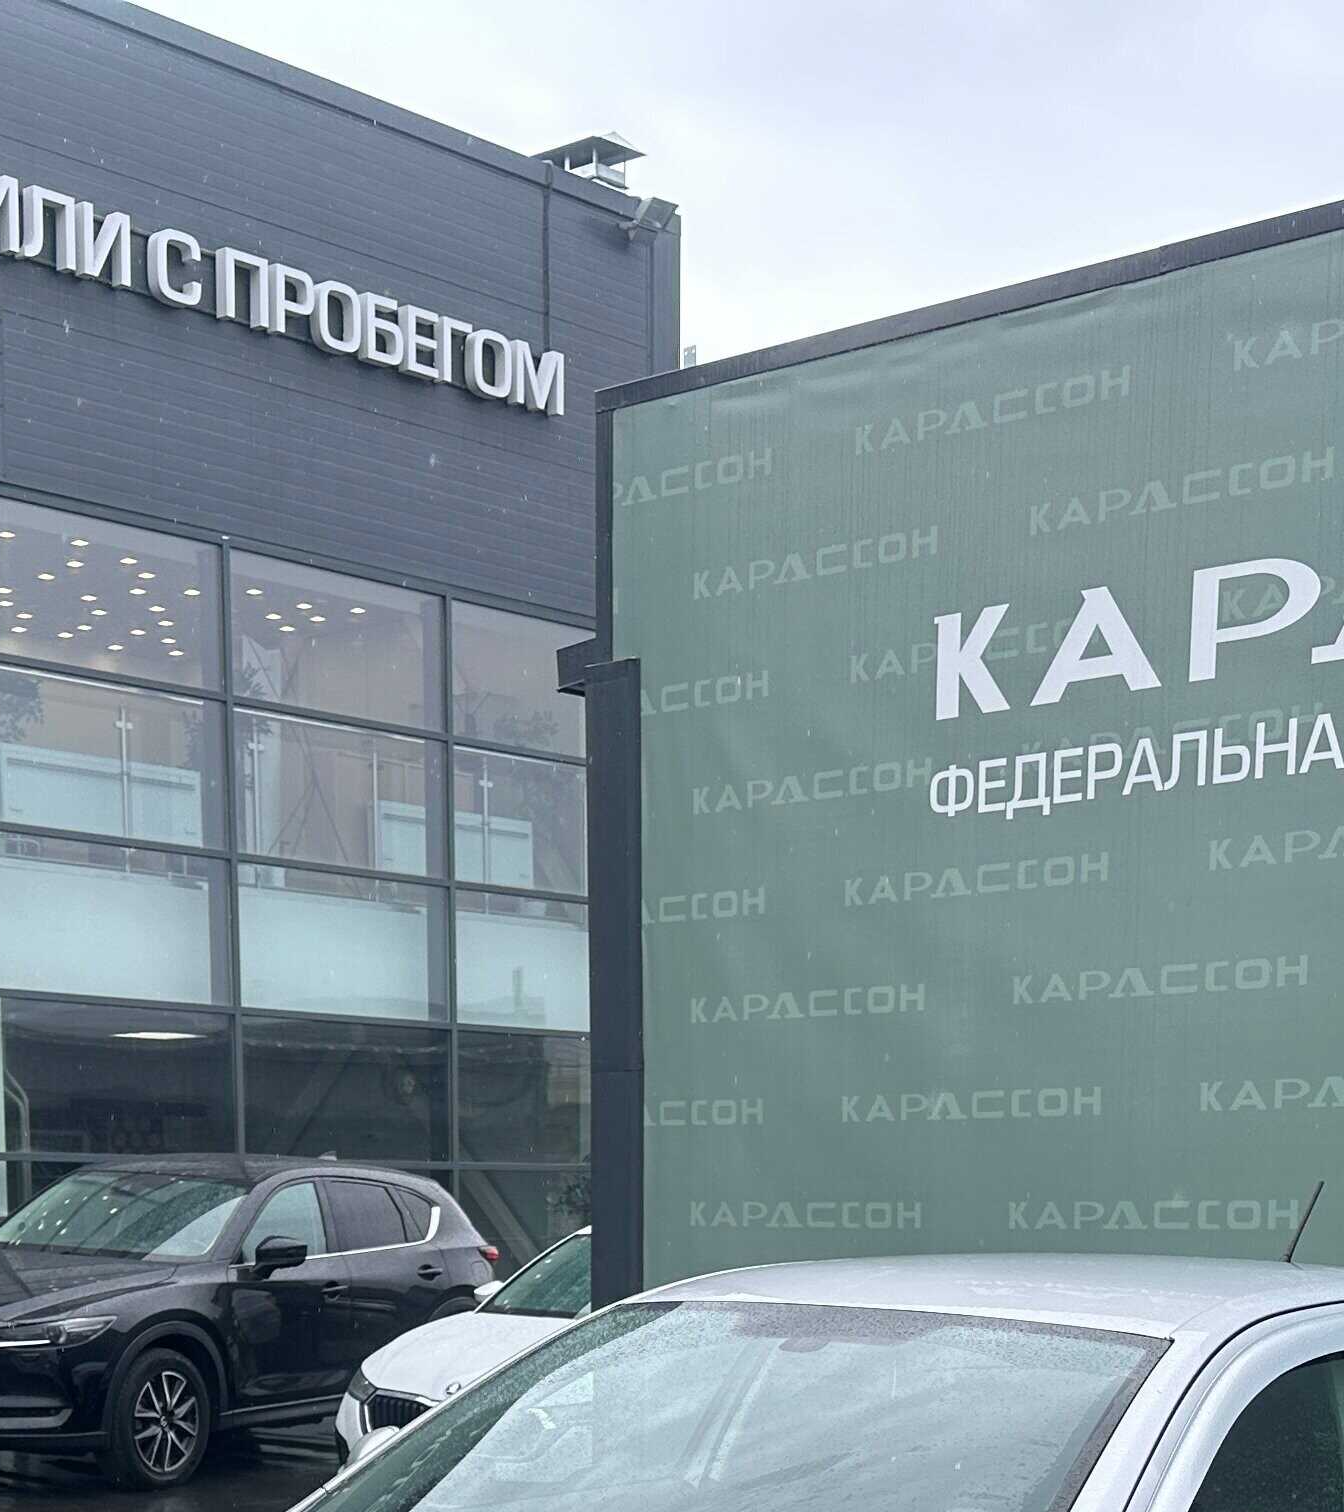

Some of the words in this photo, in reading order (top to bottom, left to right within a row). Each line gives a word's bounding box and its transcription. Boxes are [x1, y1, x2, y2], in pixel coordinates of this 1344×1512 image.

[147, 228, 201, 307] С
[215, 247, 565, 416] ПРОБЕГОМ
[856, 364, 1131, 455] КАРАССОН
[1030, 447, 1335, 536] КАРАССОН
[692, 525, 938, 600] КАРАССОН
[692, 757, 933, 815] КАРАССОН
[843, 851, 1109, 907] КАРАССОН
[691, 983, 925, 1024] КАРАССОН
[1012, 954, 1309, 1005] КАРАССОН
[841, 1086, 1102, 1124] КАРАССОН
[690, 1200, 922, 1229] КАРАССОН
[1008, 1200, 1300, 1231] КАРАССОН
